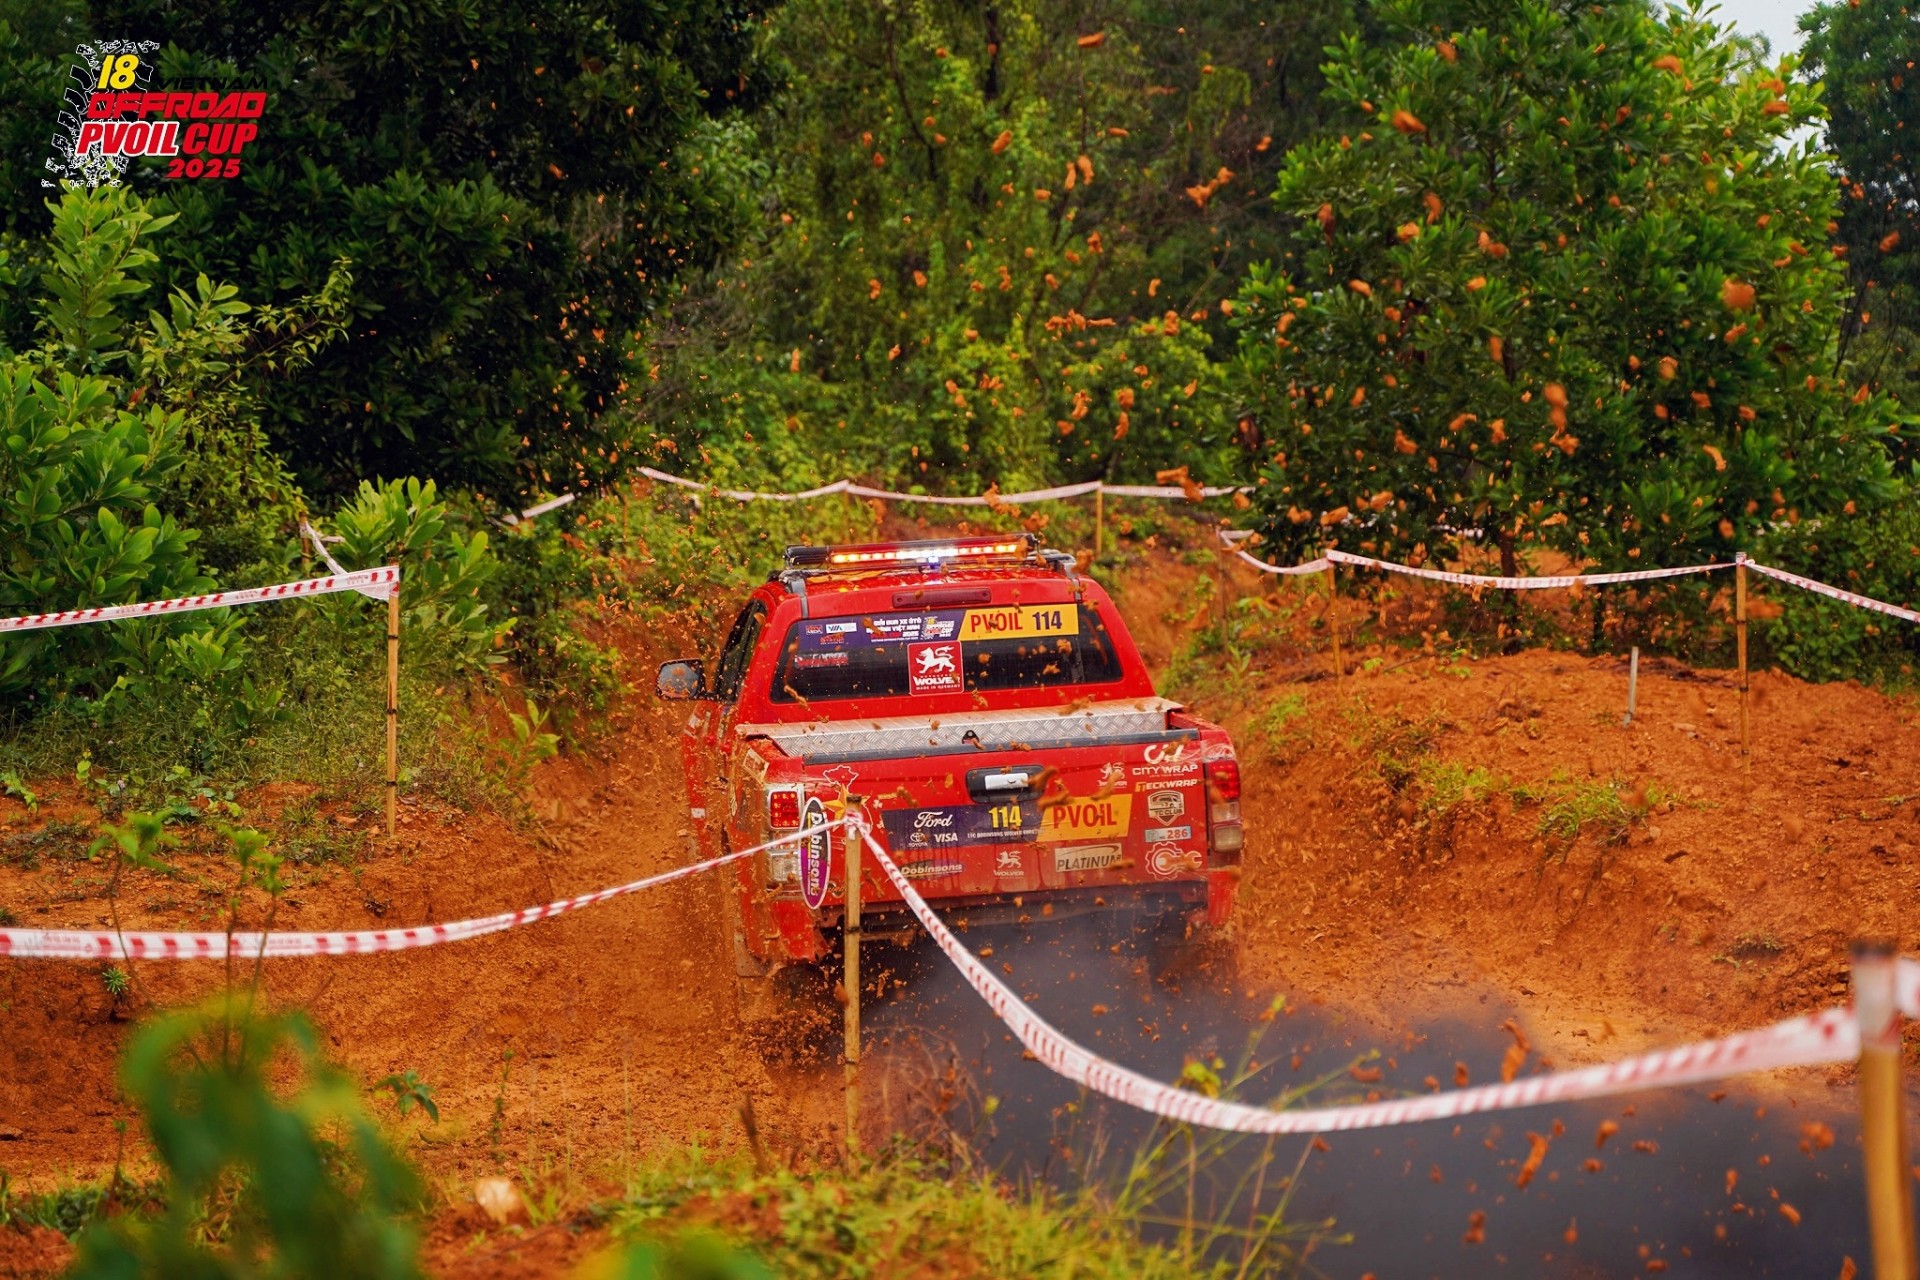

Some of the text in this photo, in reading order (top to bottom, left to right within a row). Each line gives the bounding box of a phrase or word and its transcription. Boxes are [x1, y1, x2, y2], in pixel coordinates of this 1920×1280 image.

[970, 611, 1062, 633] PVOIL 114
[1132, 766, 1160, 776] CITY
[1160, 764, 1198, 773] WRAP
[914, 811, 953, 828] Ford
[988, 803, 1117, 829] 114 PVOIL
[934, 832, 958, 843] VISA
[1167, 829, 1188, 839] 286
[901, 863, 962, 876] Dobinsons
